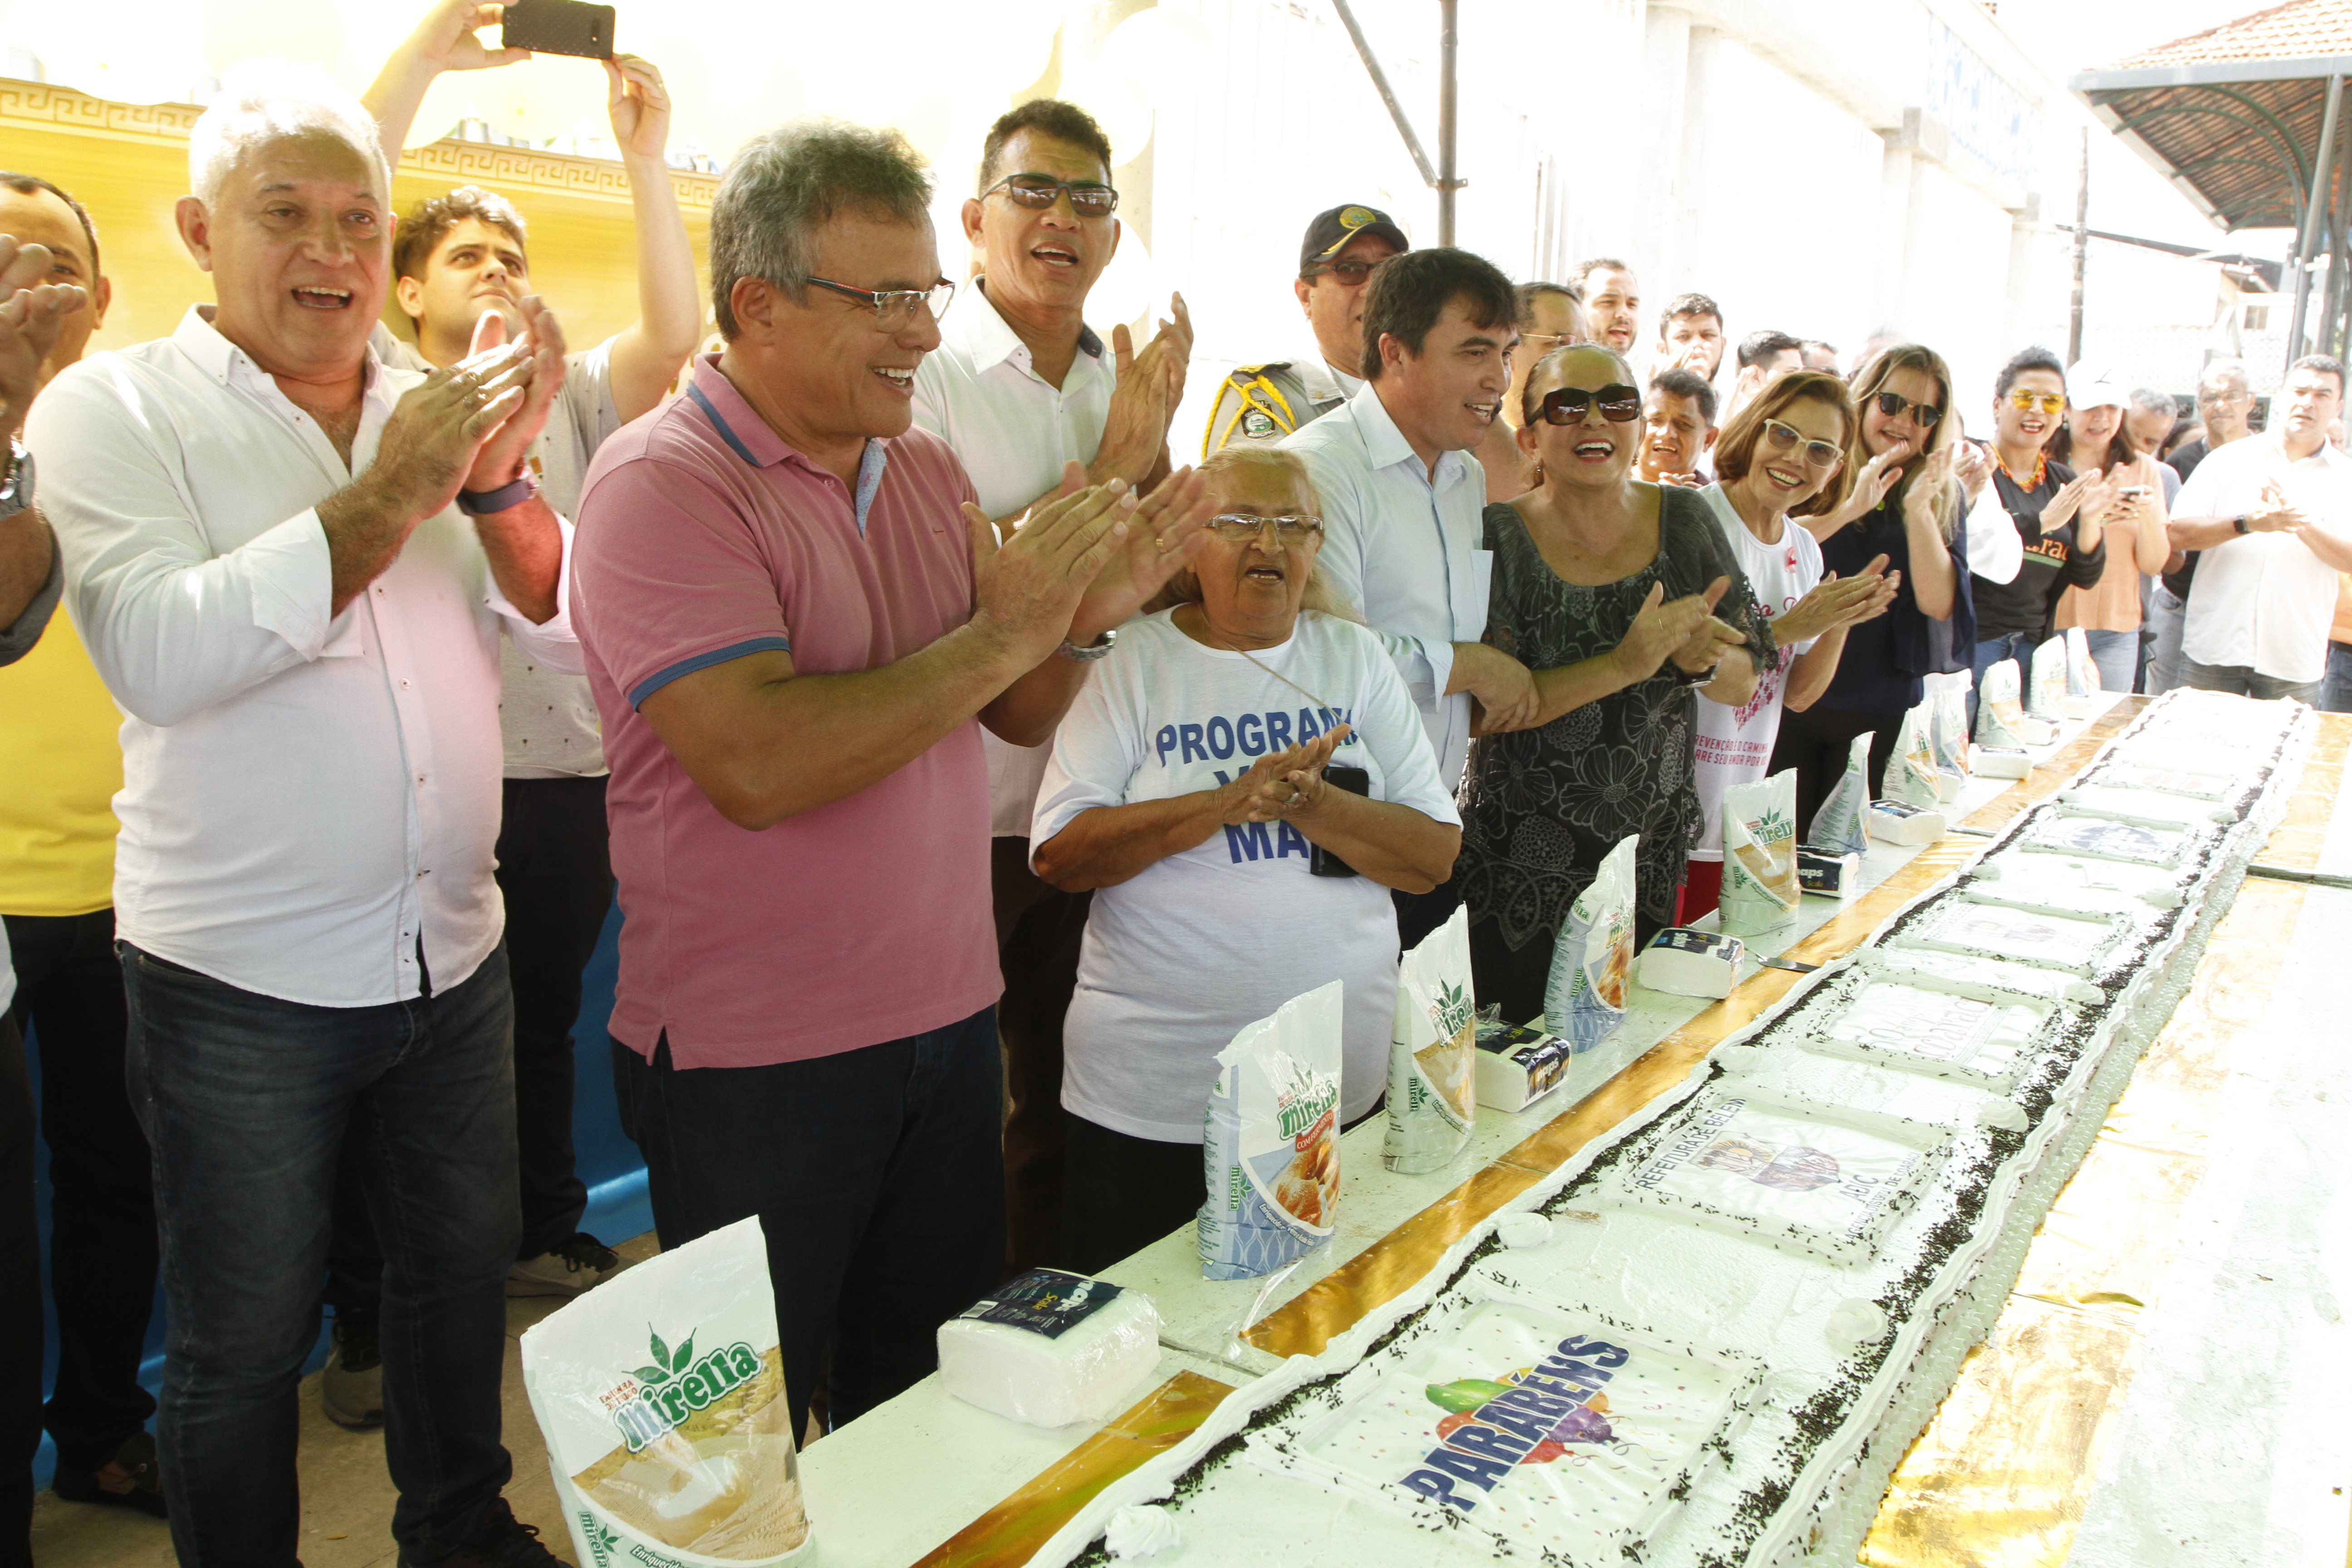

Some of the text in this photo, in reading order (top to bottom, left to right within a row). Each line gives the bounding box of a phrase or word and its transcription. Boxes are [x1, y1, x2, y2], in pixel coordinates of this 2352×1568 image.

[1695, 749, 1713, 763] ARE
[1408, 1076, 1420, 1112] mirell
[1635, 1140, 1704, 1189] REFEITURA
[1229, 1165, 1241, 1212] mirella
[1839, 1174, 1879, 1202] ADIC
[1885, 1176, 1902, 1187] DE
[1032, 1291, 1059, 1311] Scala
